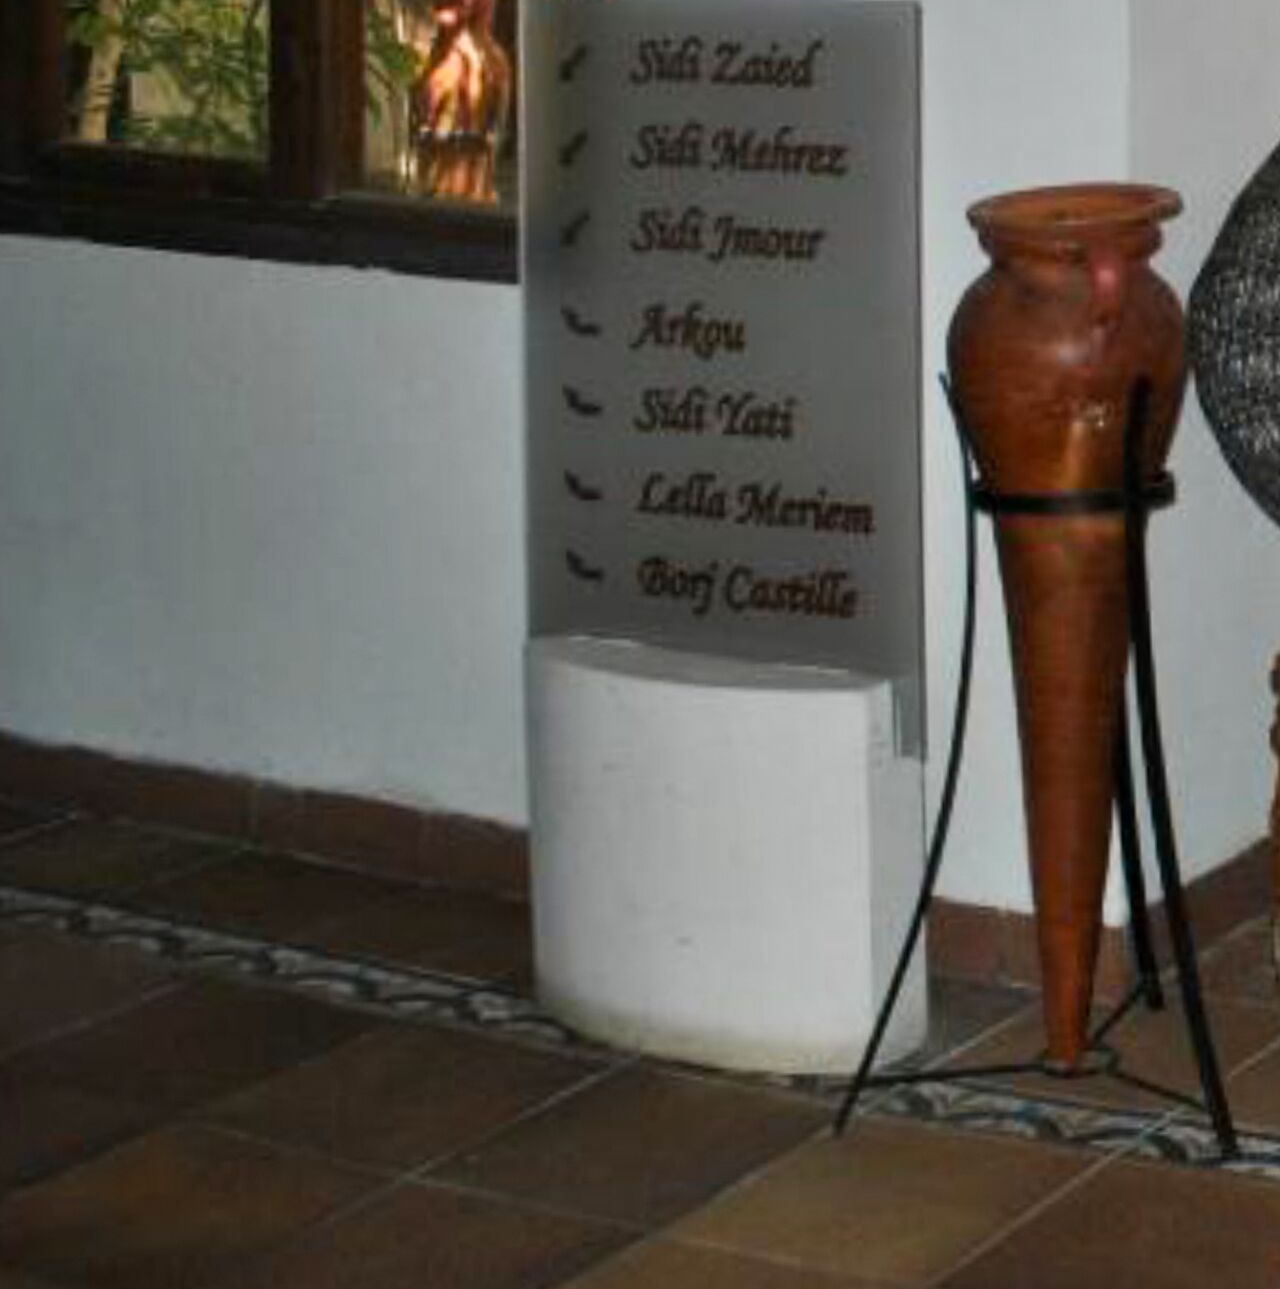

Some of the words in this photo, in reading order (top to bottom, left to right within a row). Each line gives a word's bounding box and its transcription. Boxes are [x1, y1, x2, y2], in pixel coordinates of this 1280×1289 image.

[629, 35, 702, 85] Sidi
[709, 39, 824, 89] Zaied
[629, 120, 702, 171] Sidi
[709, 124, 850, 176] Mehrez
[629, 207, 702, 253] Sidi
[632, 387, 706, 433] Sidi
[636, 472, 728, 524] Lella
[735, 480, 876, 534] Meriem
[636, 555, 718, 616] Borj
[725, 565, 861, 620] Castille
